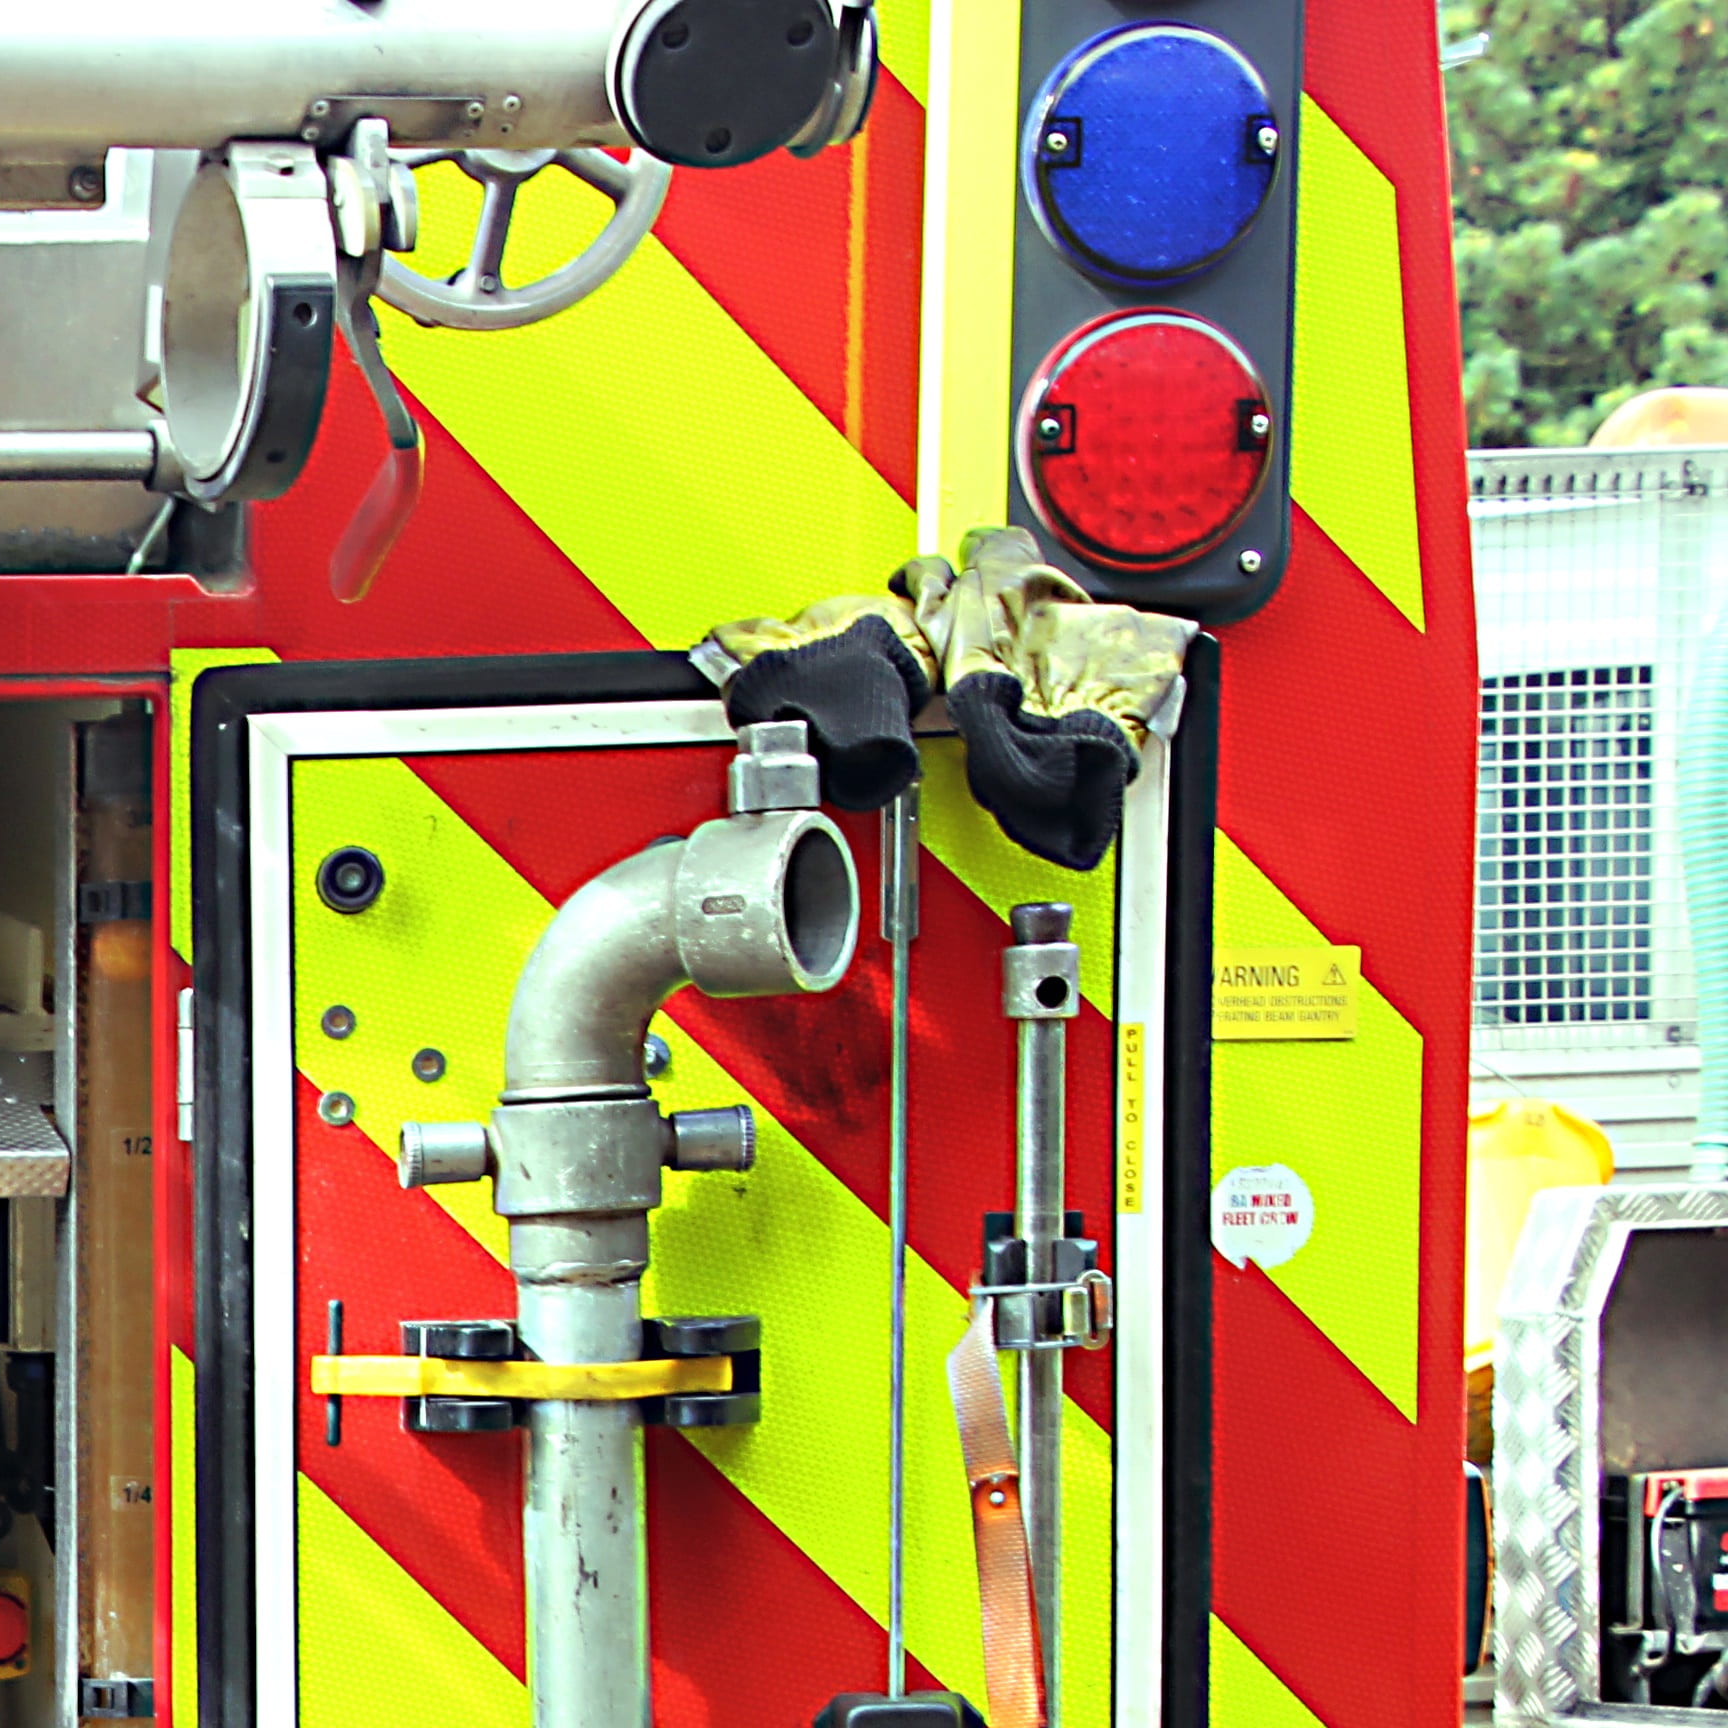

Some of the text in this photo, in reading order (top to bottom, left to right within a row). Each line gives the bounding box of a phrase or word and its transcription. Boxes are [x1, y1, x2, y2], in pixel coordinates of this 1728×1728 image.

[1216, 965, 1299, 987] ARNING
[1218, 995, 1348, 1006] VERHEAD OBSTRUCTIONS
[1218, 1011, 1339, 1022] ERATING BEAM GANTRY
[1125, 1030, 1138, 1207] PULL TO CLOSE
